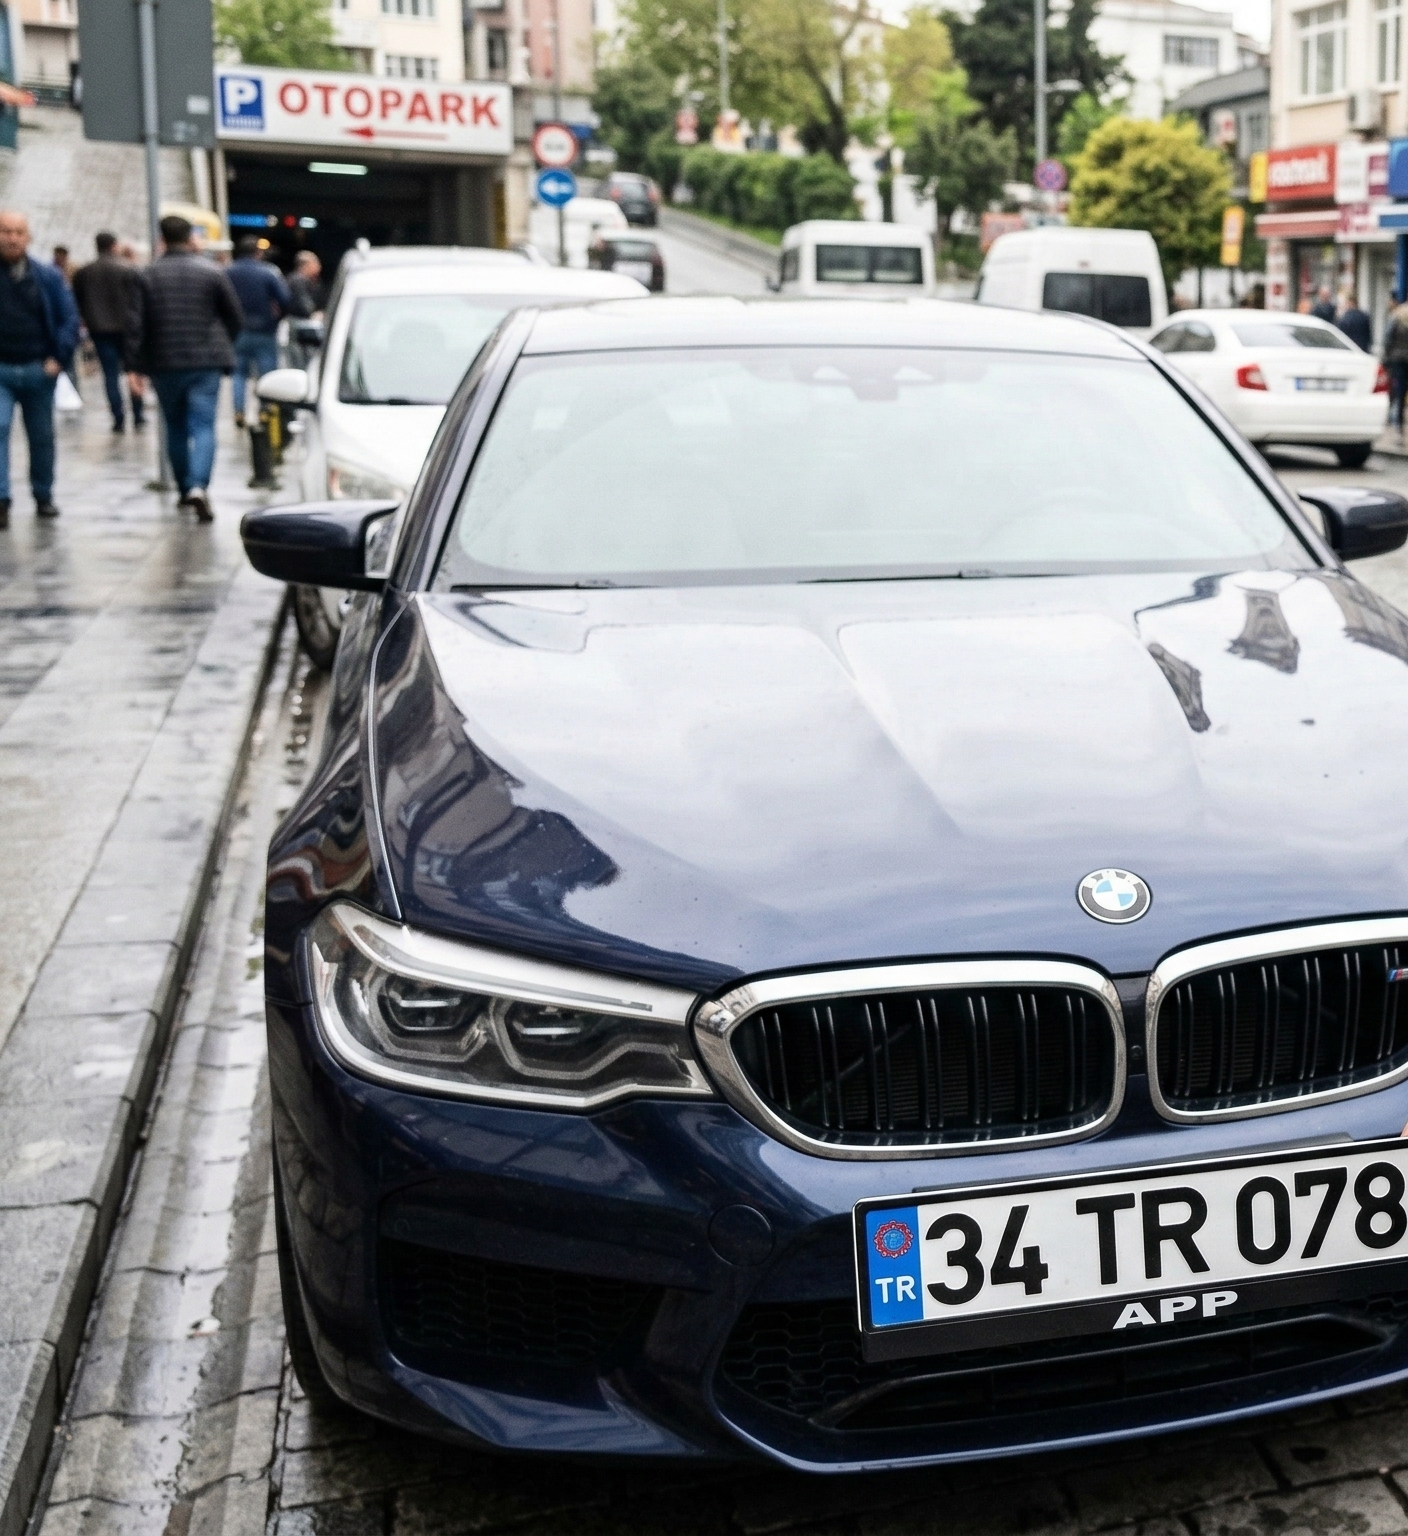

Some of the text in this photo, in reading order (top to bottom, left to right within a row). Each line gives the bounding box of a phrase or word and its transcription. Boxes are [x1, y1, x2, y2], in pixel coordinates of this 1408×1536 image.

[224, 79, 501, 128] P OTOPARK
[925, 1204, 1049, 1306] 34
[1075, 1186, 1211, 1286] TR
[874, 1275, 917, 1304] TR
[1112, 1290, 1239, 1330] APP
